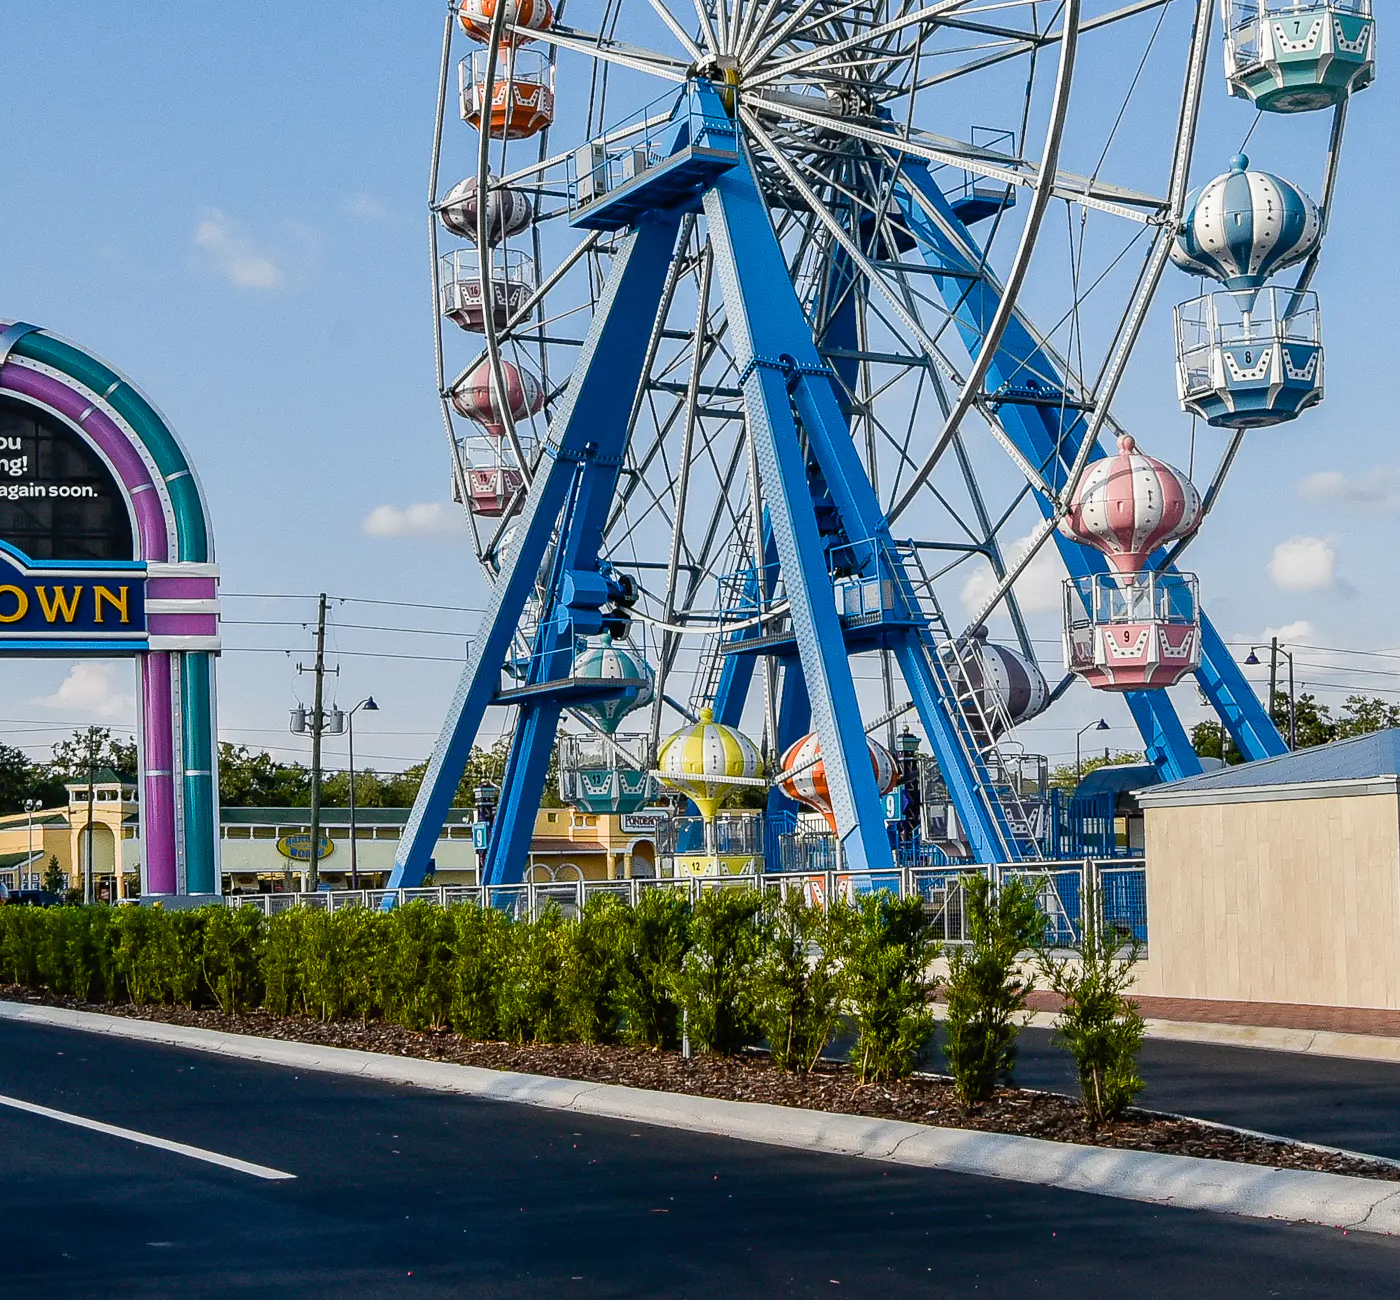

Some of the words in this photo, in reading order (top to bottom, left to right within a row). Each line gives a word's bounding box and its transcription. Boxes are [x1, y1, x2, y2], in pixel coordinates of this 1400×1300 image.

[1293, 21, 1300, 35] 7
[1245, 350, 1252, 364] 8
[0, 455, 28, 476] ng!
[479, 473, 488, 483] 15
[0, 482, 46, 500] again
[48, 485, 98, 498] soon.
[0, 584, 129, 623] OWN
[1123, 630, 1130, 643] 9
[592, 774, 601, 785] 13
[886, 794, 895, 819] 9
[476, 829, 483, 847] 9
[692, 861, 701, 871] 12
